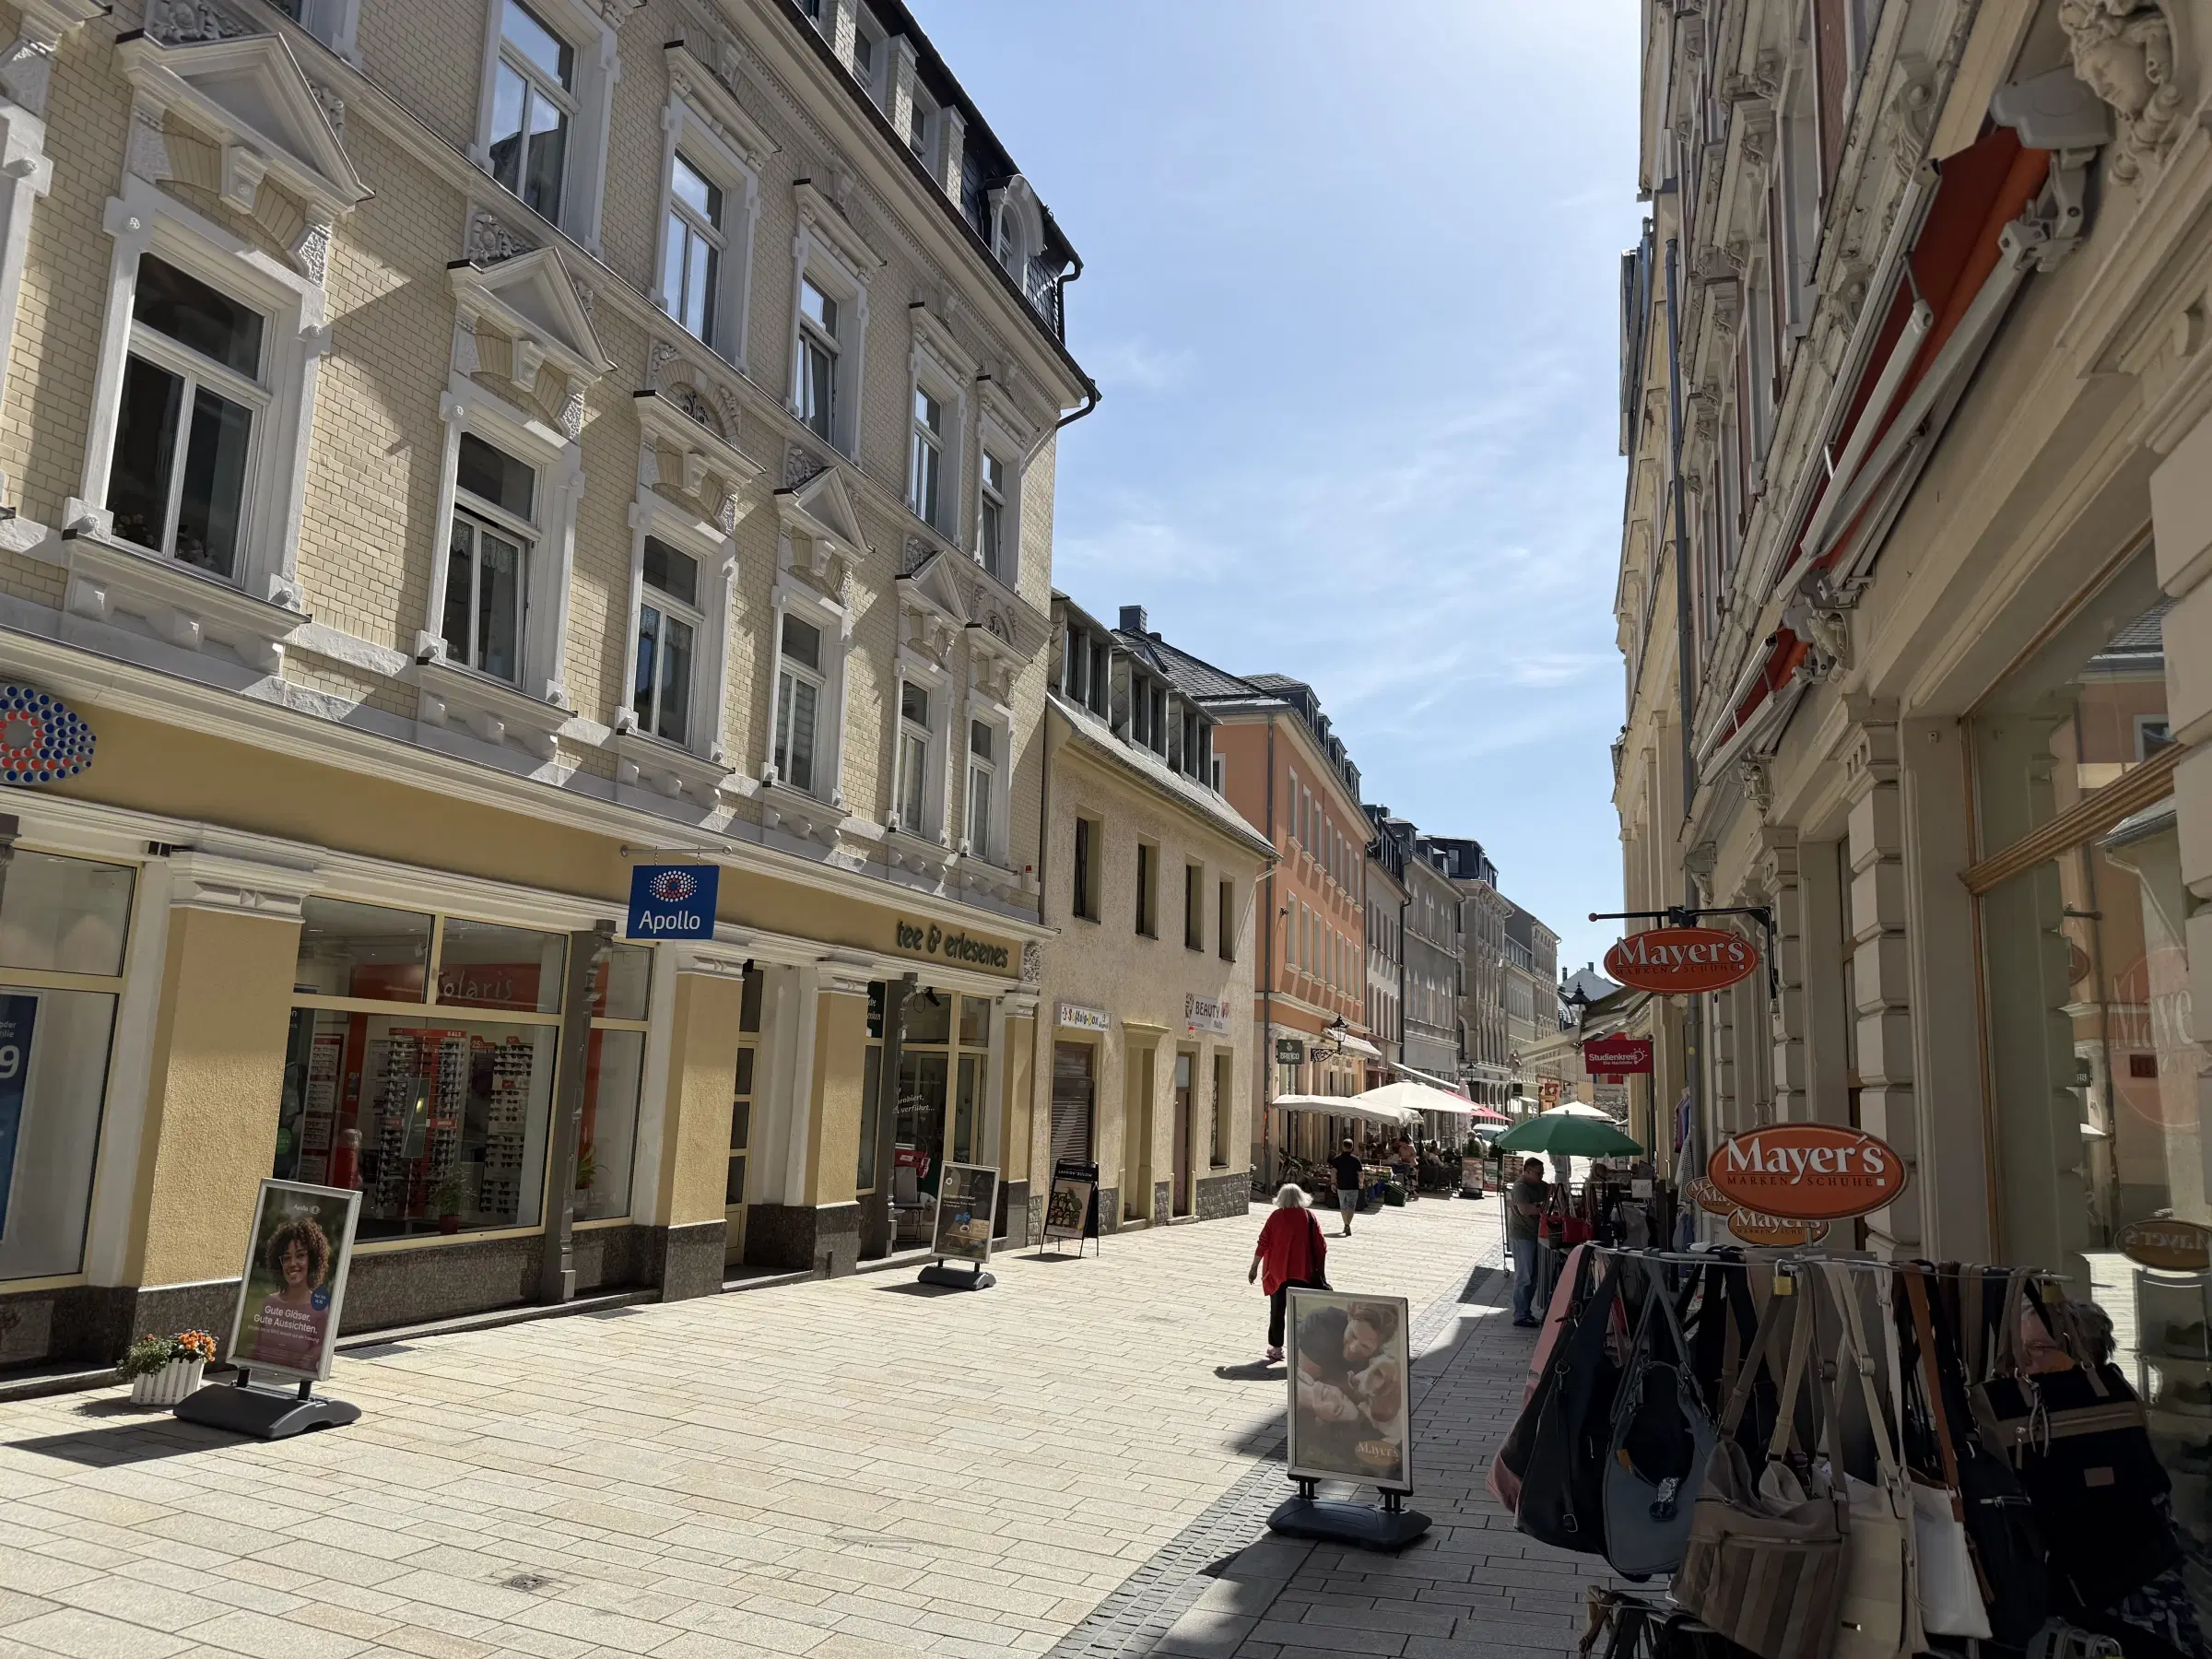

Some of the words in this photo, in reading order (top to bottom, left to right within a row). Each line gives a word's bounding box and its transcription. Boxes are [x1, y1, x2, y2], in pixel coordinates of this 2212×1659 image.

[639, 911, 700, 935] Apollo
[897, 920, 924, 951] tee
[927, 924, 942, 954] &
[945, 932, 1009, 969] erlesenes
[1616, 933, 1745, 973] Mayer's
[1616, 967, 1669, 976] MARKEN
[1684, 964, 1739, 973] SCHUHE
[1195, 1001, 1220, 1018] BEAUTY
[2110, 972, 2194, 1072] Maye
[1588, 1053, 1638, 1062] Studienkreis
[1725, 1134, 1886, 1185] Mayer's
[1727, 1175, 1788, 1186] MARKEN
[1806, 1176, 1873, 1187] SCHUHE
[253, 1313, 273, 1325] Gute
[274, 1318, 318, 1334] Aussichten.
[265, 1305, 284, 1316] Gute
[285, 1309, 311, 1322] Gläser.
